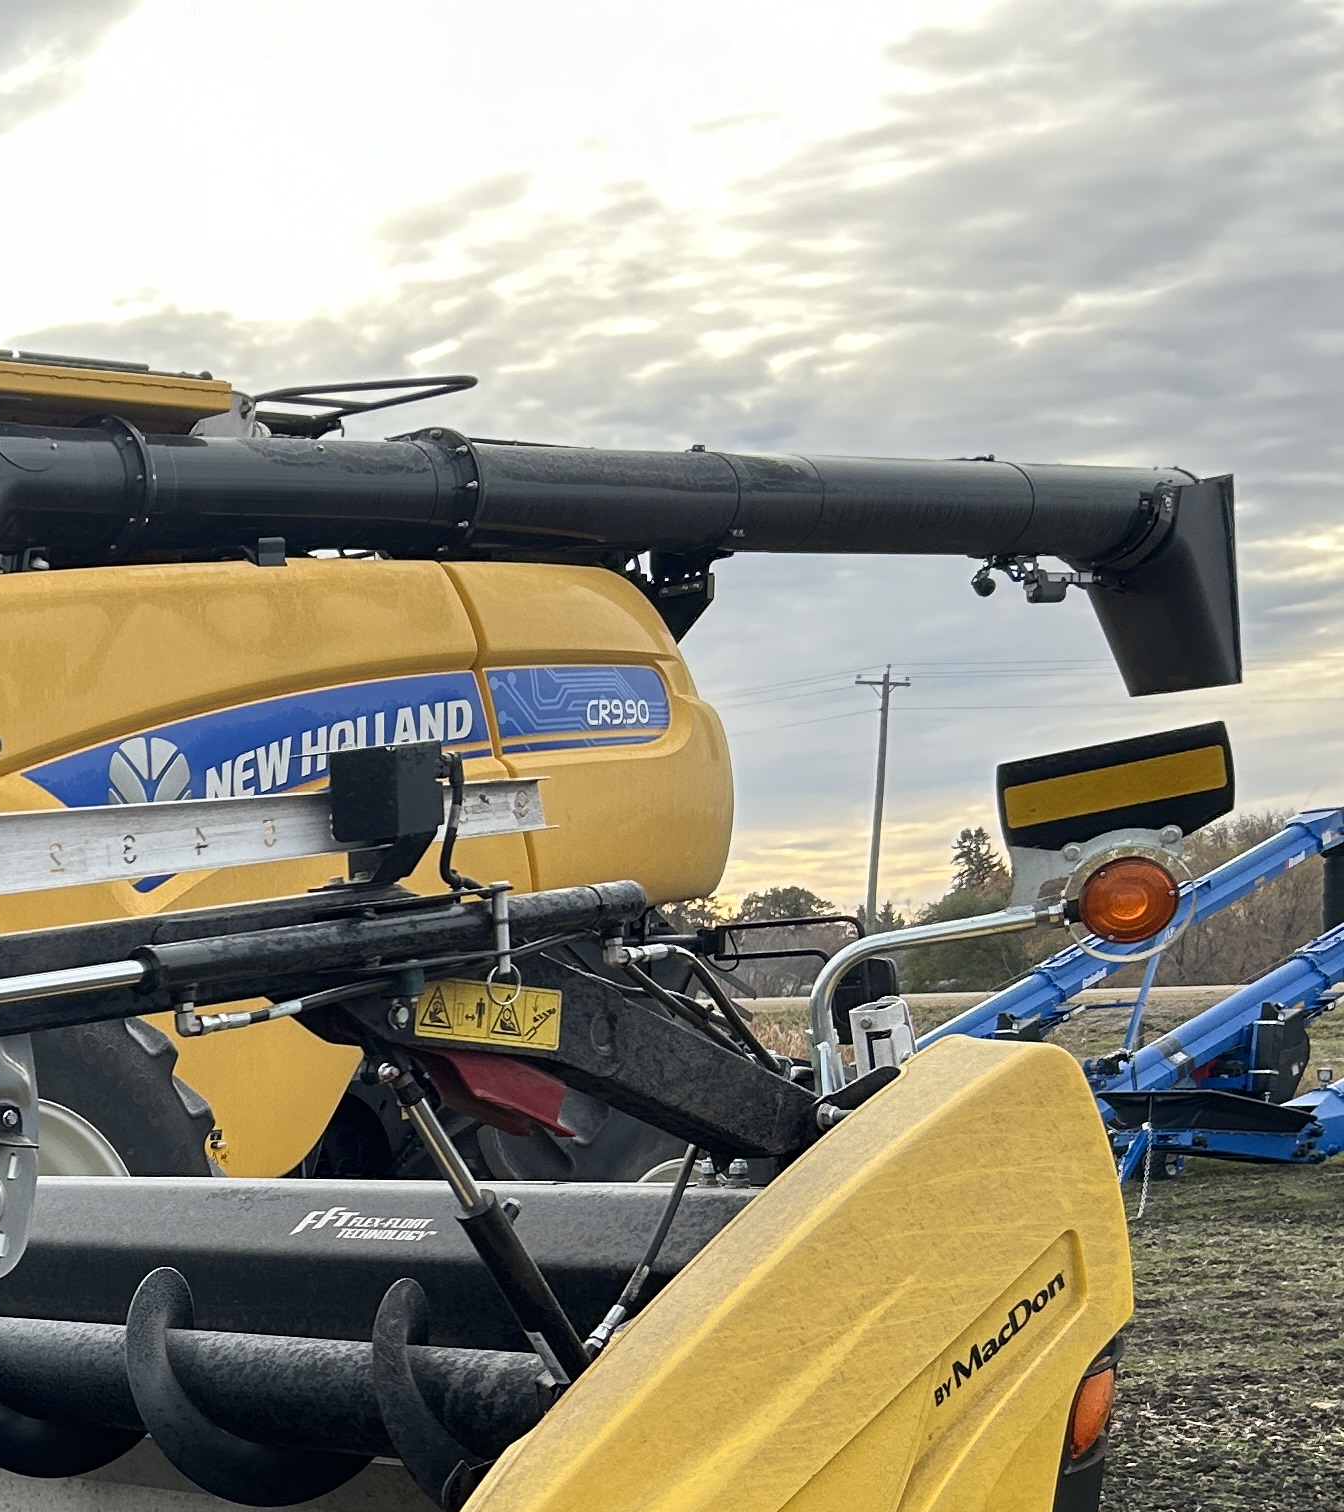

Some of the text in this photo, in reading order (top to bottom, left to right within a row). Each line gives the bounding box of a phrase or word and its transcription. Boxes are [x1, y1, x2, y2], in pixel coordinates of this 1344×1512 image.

[586, 699, 650, 726] CR9.90
[205, 736, 293, 799] NEW
[289, 1206, 434, 1235] FFT FLEX-FLOAT
[934, 1272, 1065, 1407] BY MacDon
